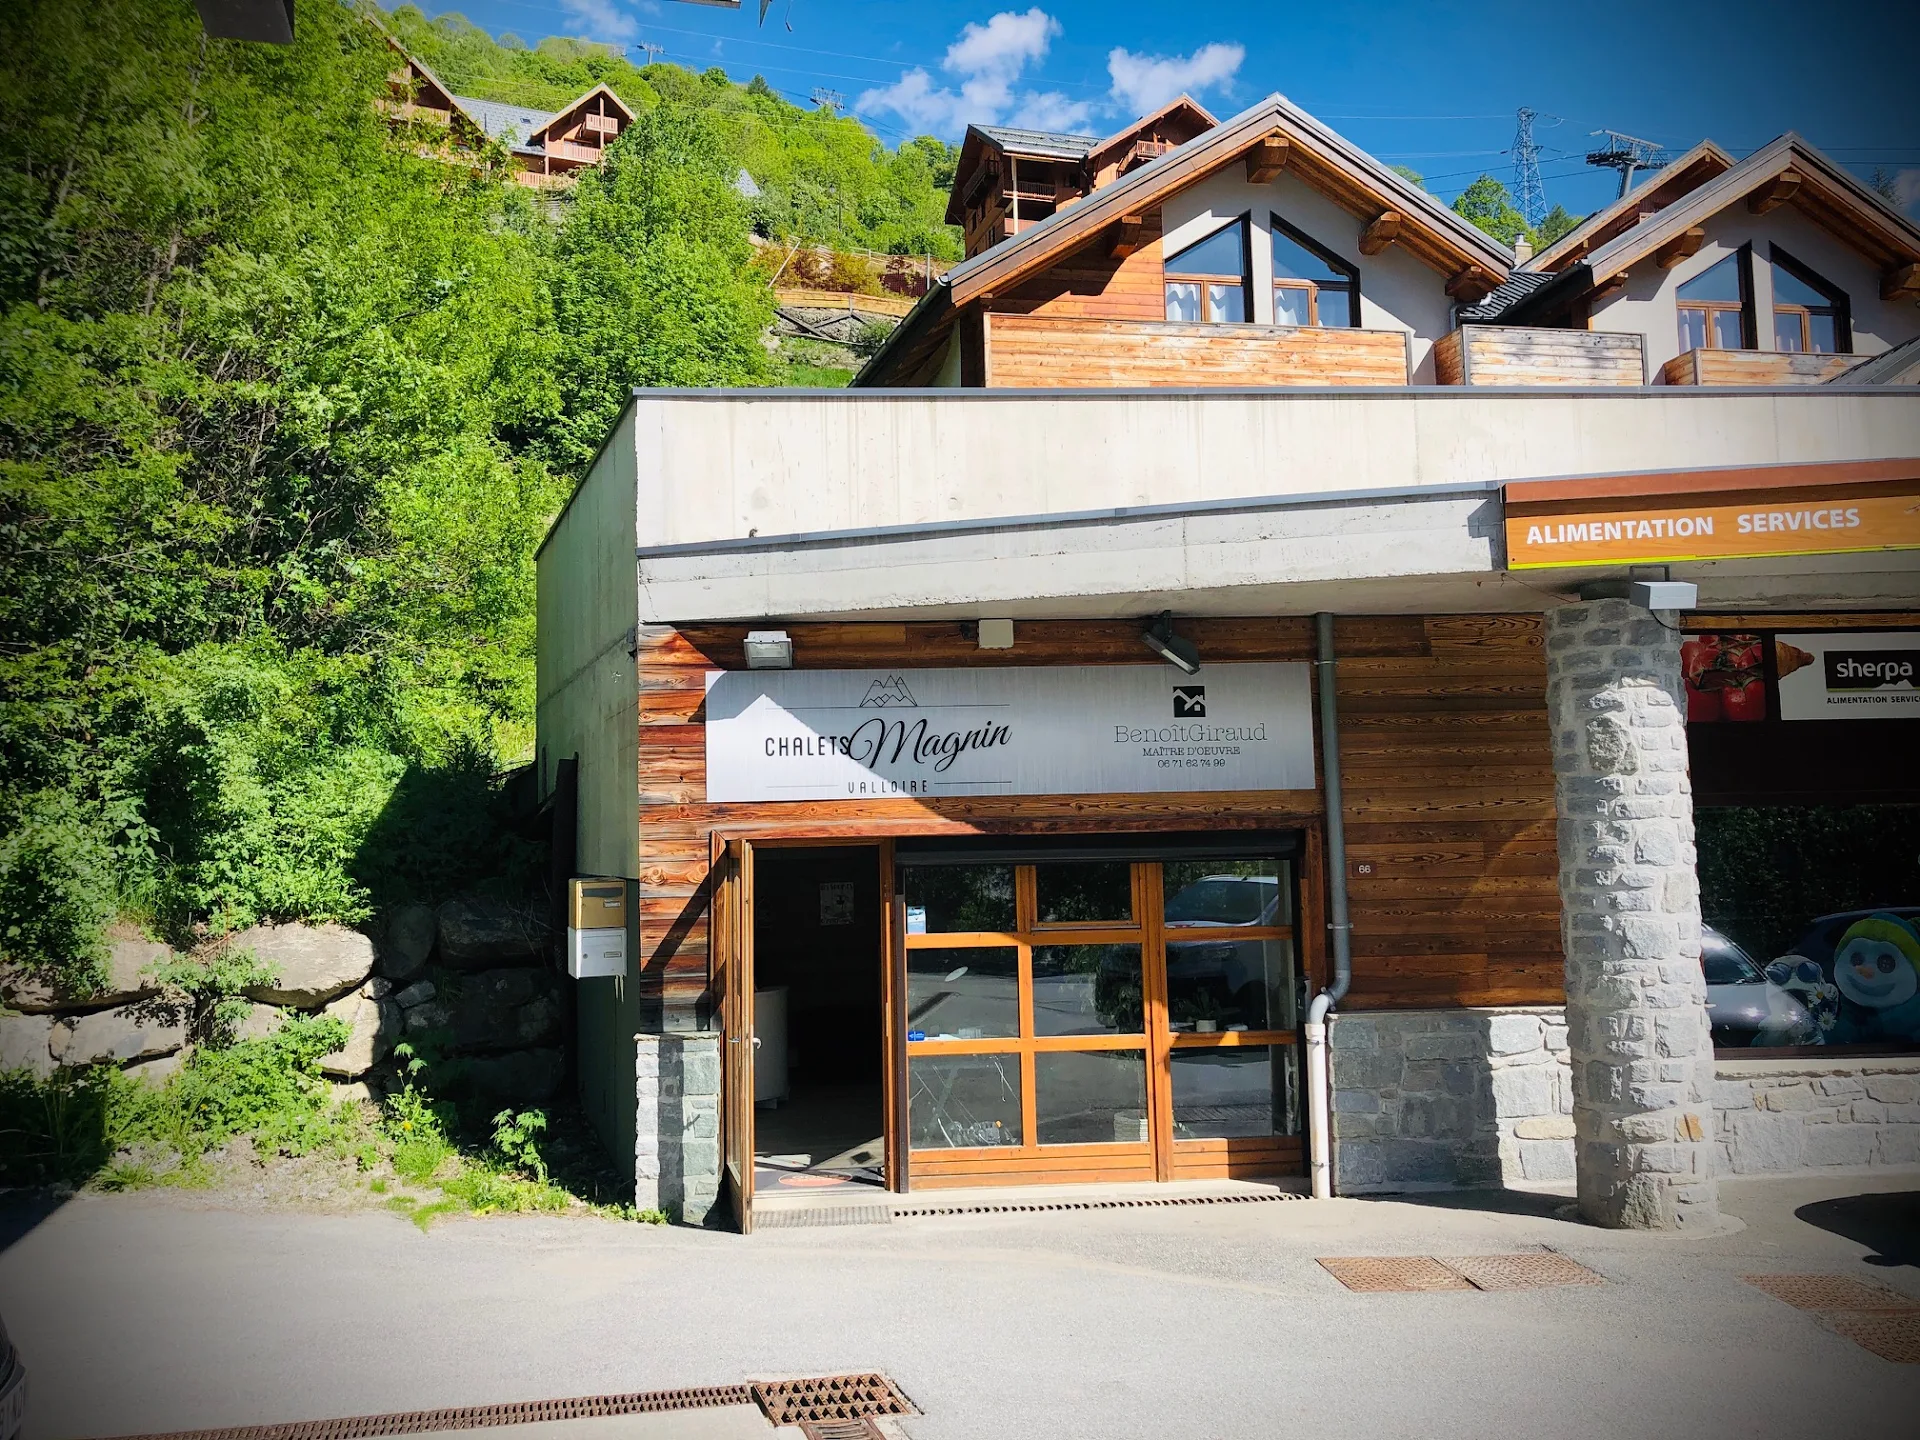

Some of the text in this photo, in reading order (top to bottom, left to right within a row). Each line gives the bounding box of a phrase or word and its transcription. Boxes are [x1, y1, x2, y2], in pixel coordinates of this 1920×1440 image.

[1526, 508, 1861, 545] ALIMENTATION SERVICES
[1836, 658, 1913, 681] sherpa
[1826, 695, 1920, 704] ALIMENTATION SERVIC
[765, 718, 1013, 772] CHALETS Magnin
[1142, 746, 1241, 757] MAÎTRE D'OEUVRE
[1172, 760, 1183, 768] 71
[1200, 759, 1211, 767] 74
[1213, 759, 1226, 767] 99
[848, 780, 928, 794] VALLOIRE
